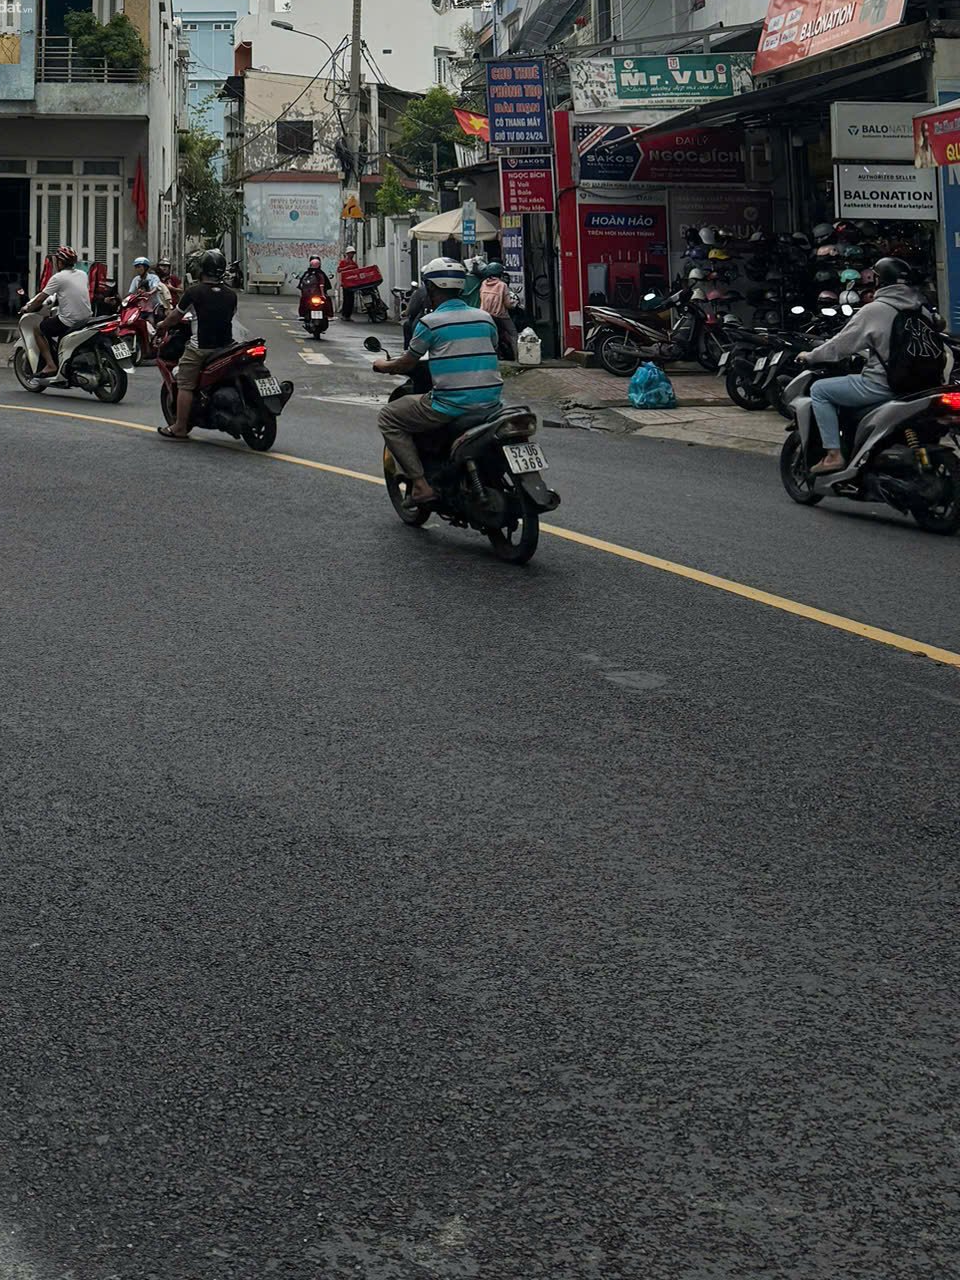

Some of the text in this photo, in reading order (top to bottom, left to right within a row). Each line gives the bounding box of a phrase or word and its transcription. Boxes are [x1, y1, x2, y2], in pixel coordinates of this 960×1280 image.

[800, 2, 858, 41] BALONATION
[491, 64, 540, 80] CHO THUÊ
[490, 82, 543, 99] PHÒNG TRỌ
[495, 116, 541, 127] CÓ THANG MÁY
[862, 124, 912, 134] BALONATI
[495, 130, 543, 141] GIỜ TỰ DO 24/24
[587, 154, 635, 163] SAKOS
[649, 150, 699, 165] NGỌC
[508, 172, 529, 180] NGỌC
[843, 190, 933, 201] BALONATION
[591, 215, 654, 226] HOÀN HẢO
[515, 456, 543, 471] 1368
